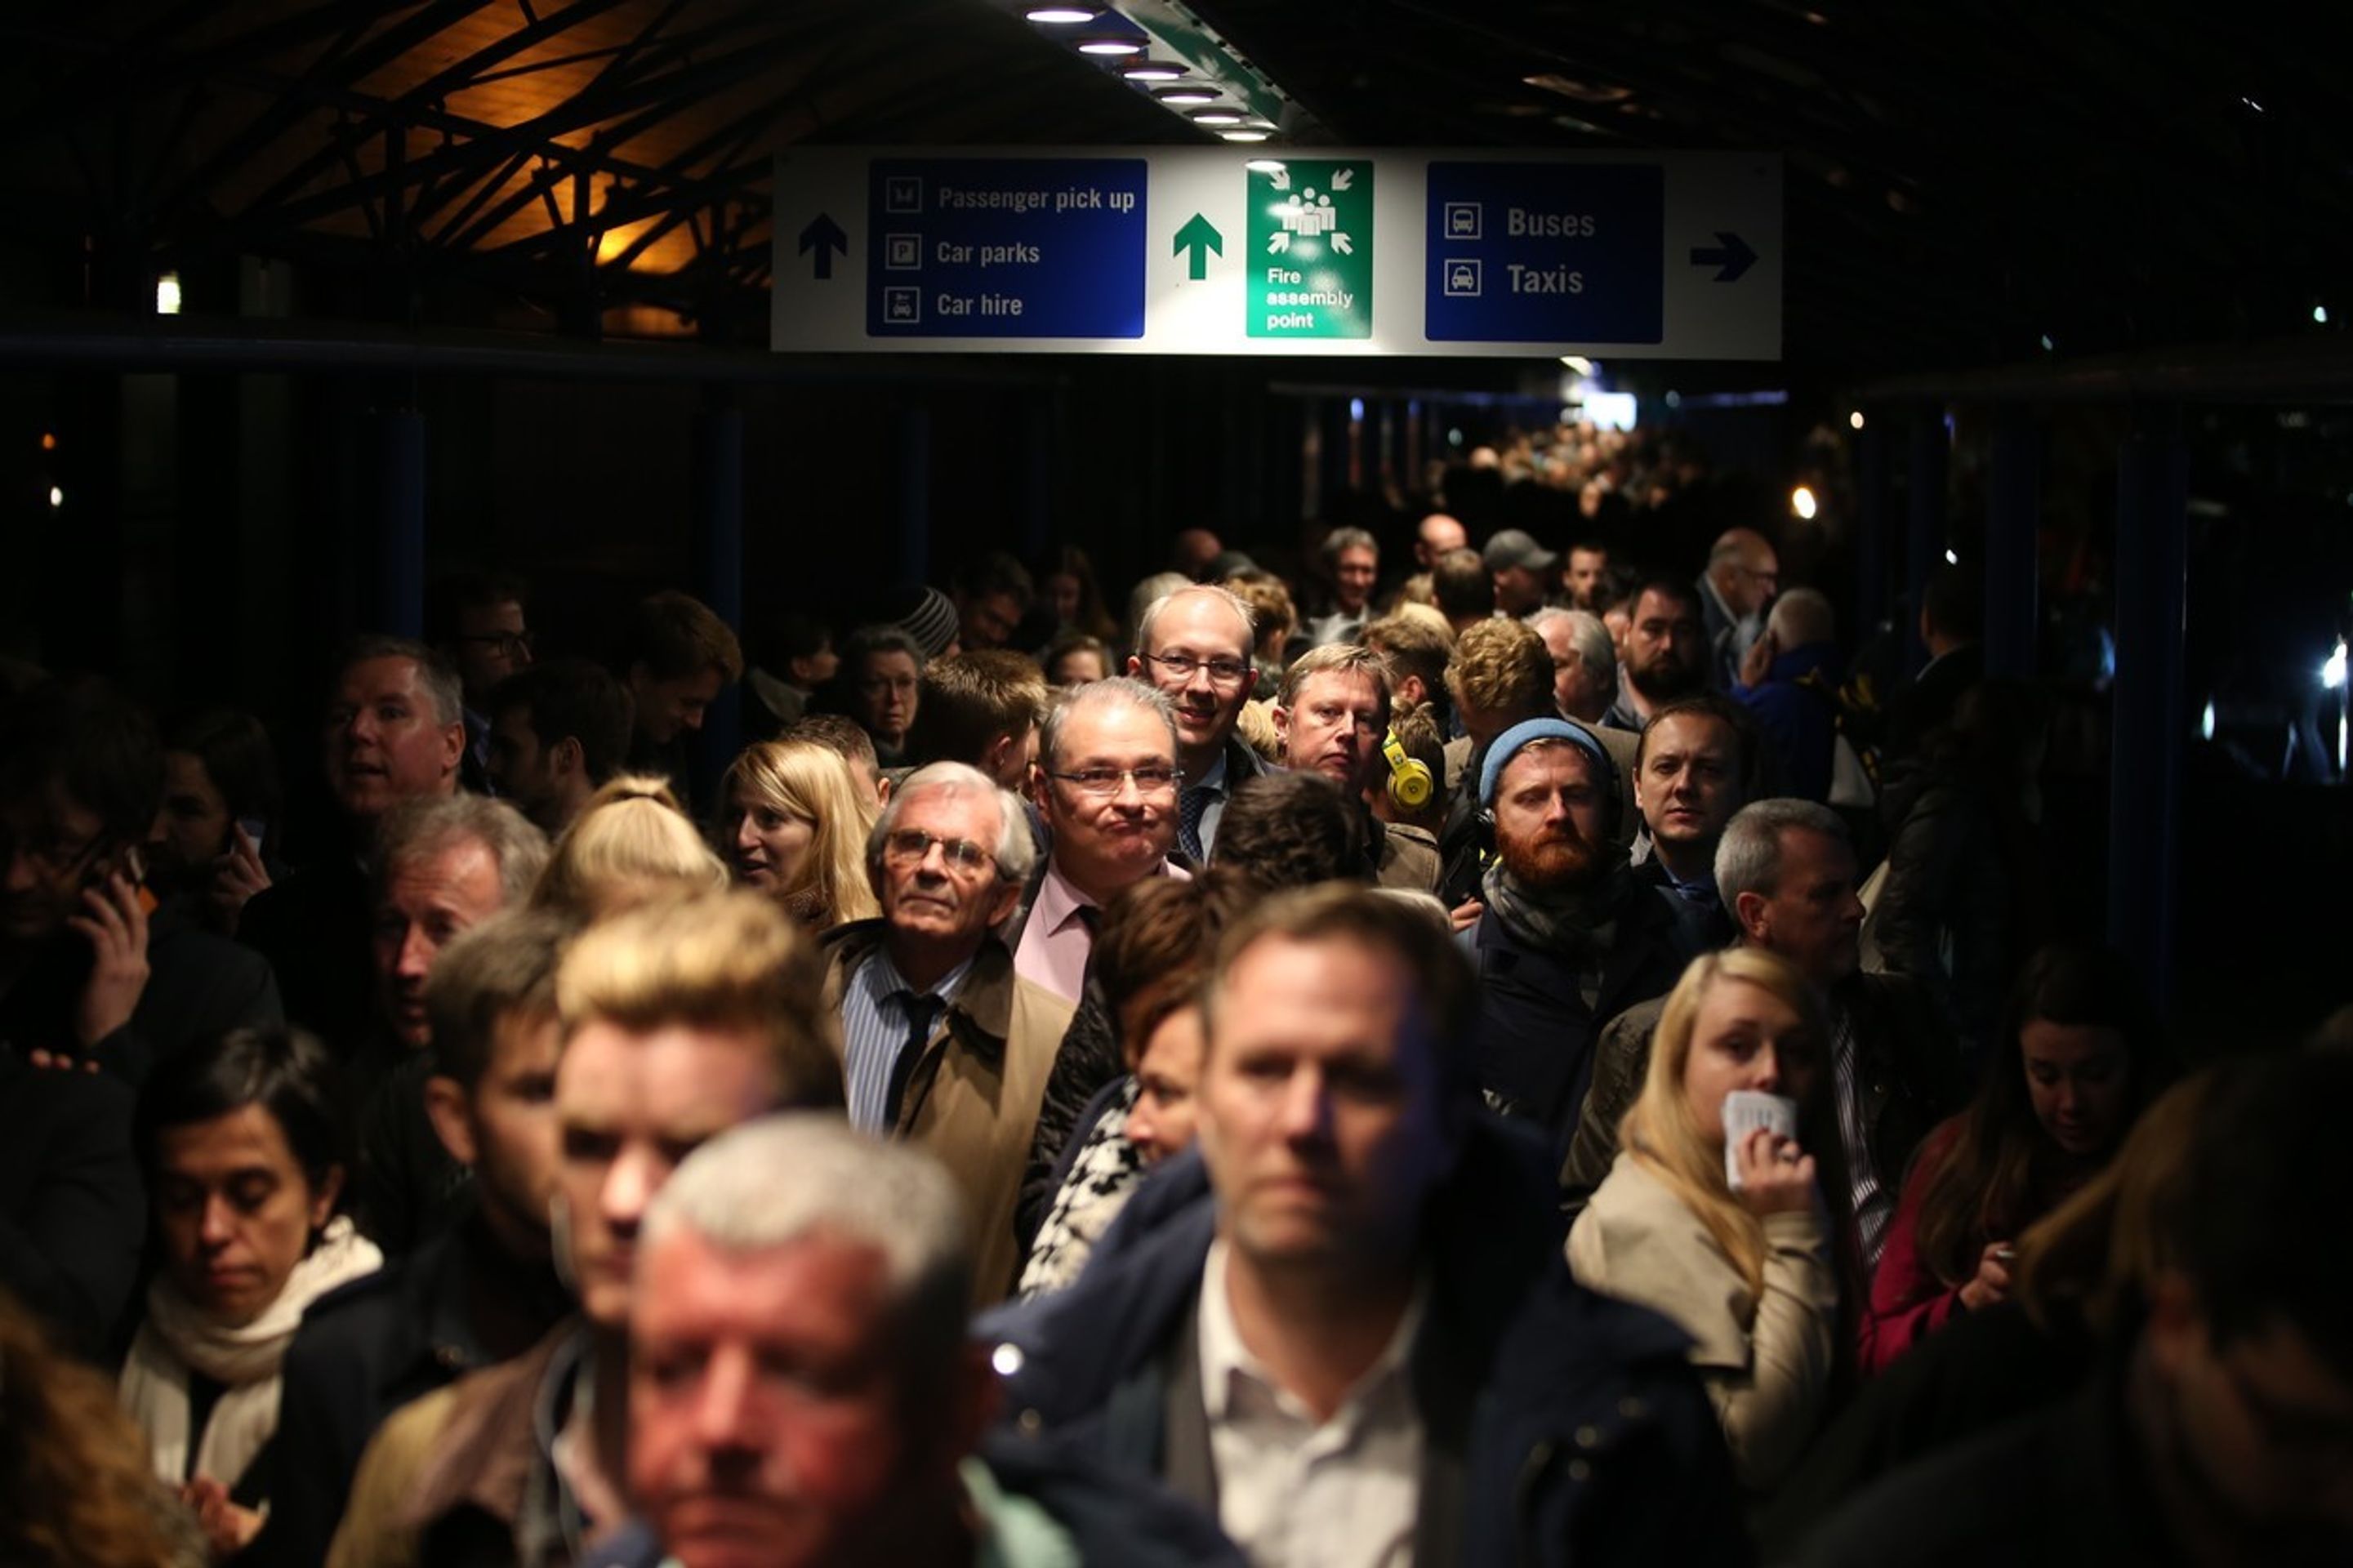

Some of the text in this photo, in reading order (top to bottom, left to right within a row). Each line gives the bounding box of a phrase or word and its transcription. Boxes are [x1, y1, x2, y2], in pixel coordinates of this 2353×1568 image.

[939, 187, 1135, 214] Passenger pick up
[1507, 207, 1597, 238] Buses
[938, 241, 1041, 269] Car parks
[1267, 267, 1302, 284] Fire
[1506, 263, 1584, 295] Taxis
[938, 293, 1023, 316] Car hire
[1266, 290, 1353, 309] assembly
[1267, 312, 1314, 331] point
